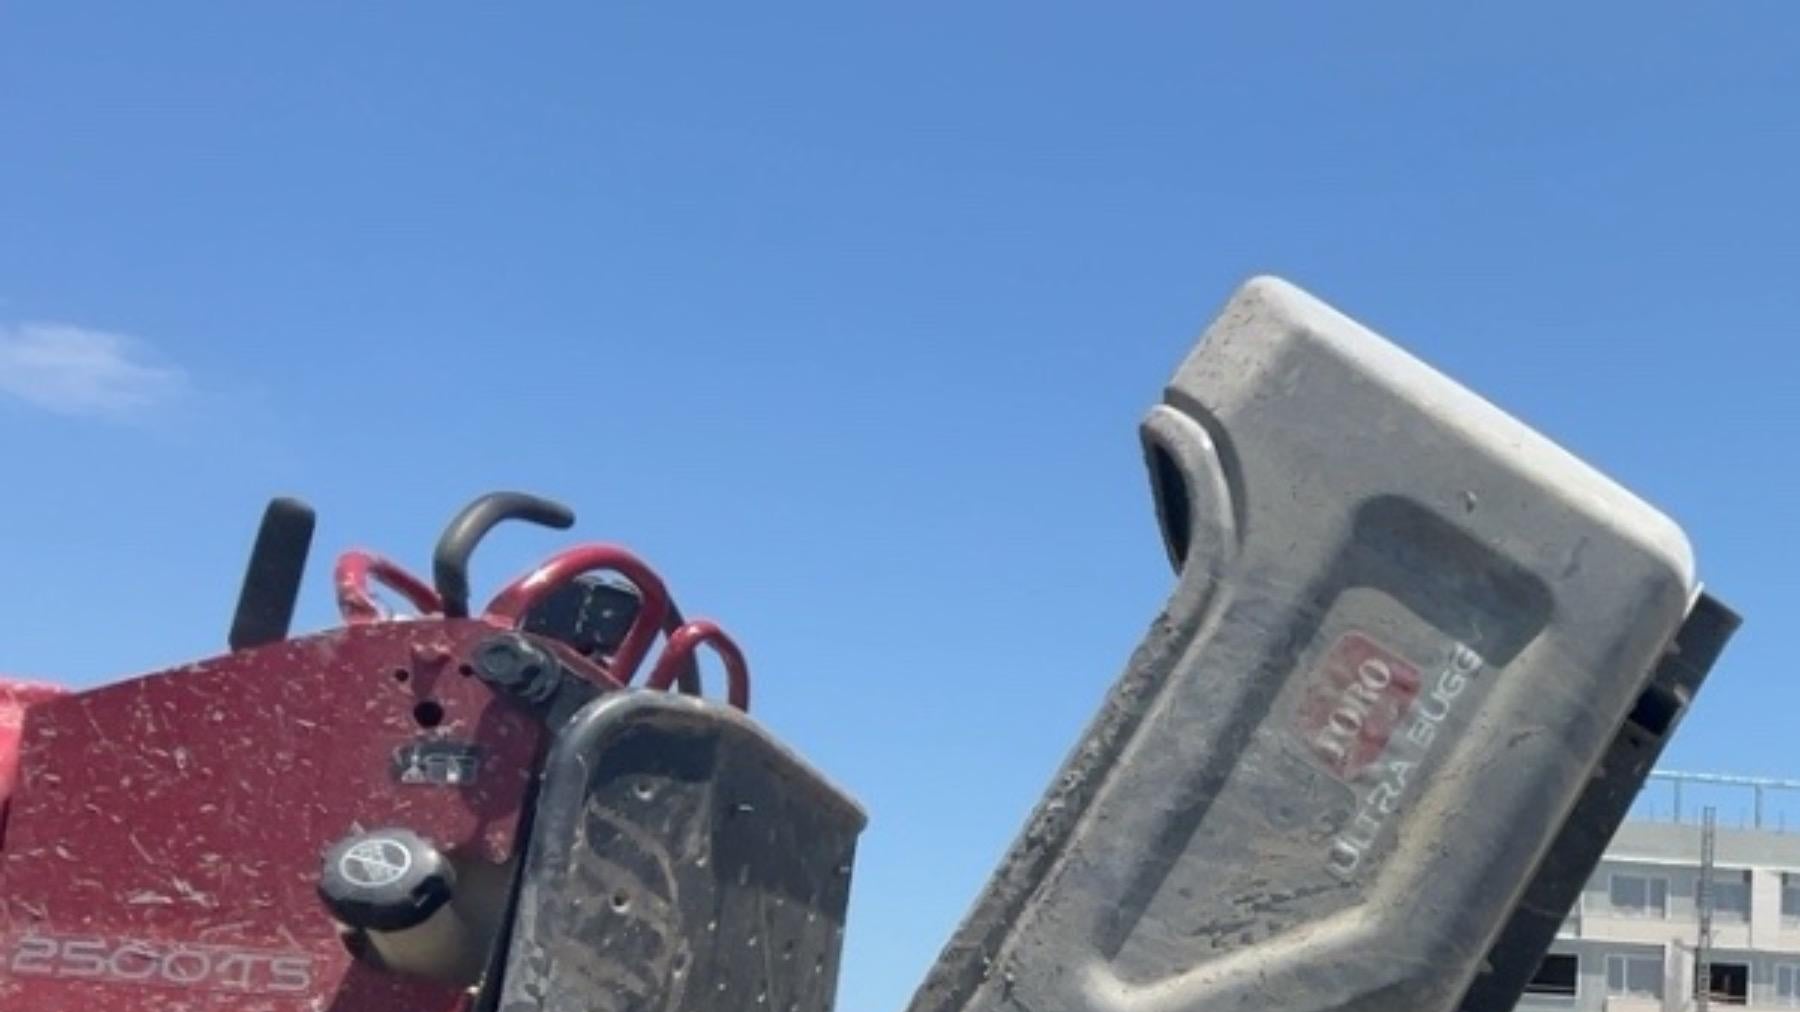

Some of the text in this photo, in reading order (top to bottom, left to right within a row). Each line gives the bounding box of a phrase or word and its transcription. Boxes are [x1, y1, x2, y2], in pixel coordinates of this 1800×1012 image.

[1314, 658, 1391, 758] TORO
[1324, 622, 1484, 882] ULTRA BUGG
